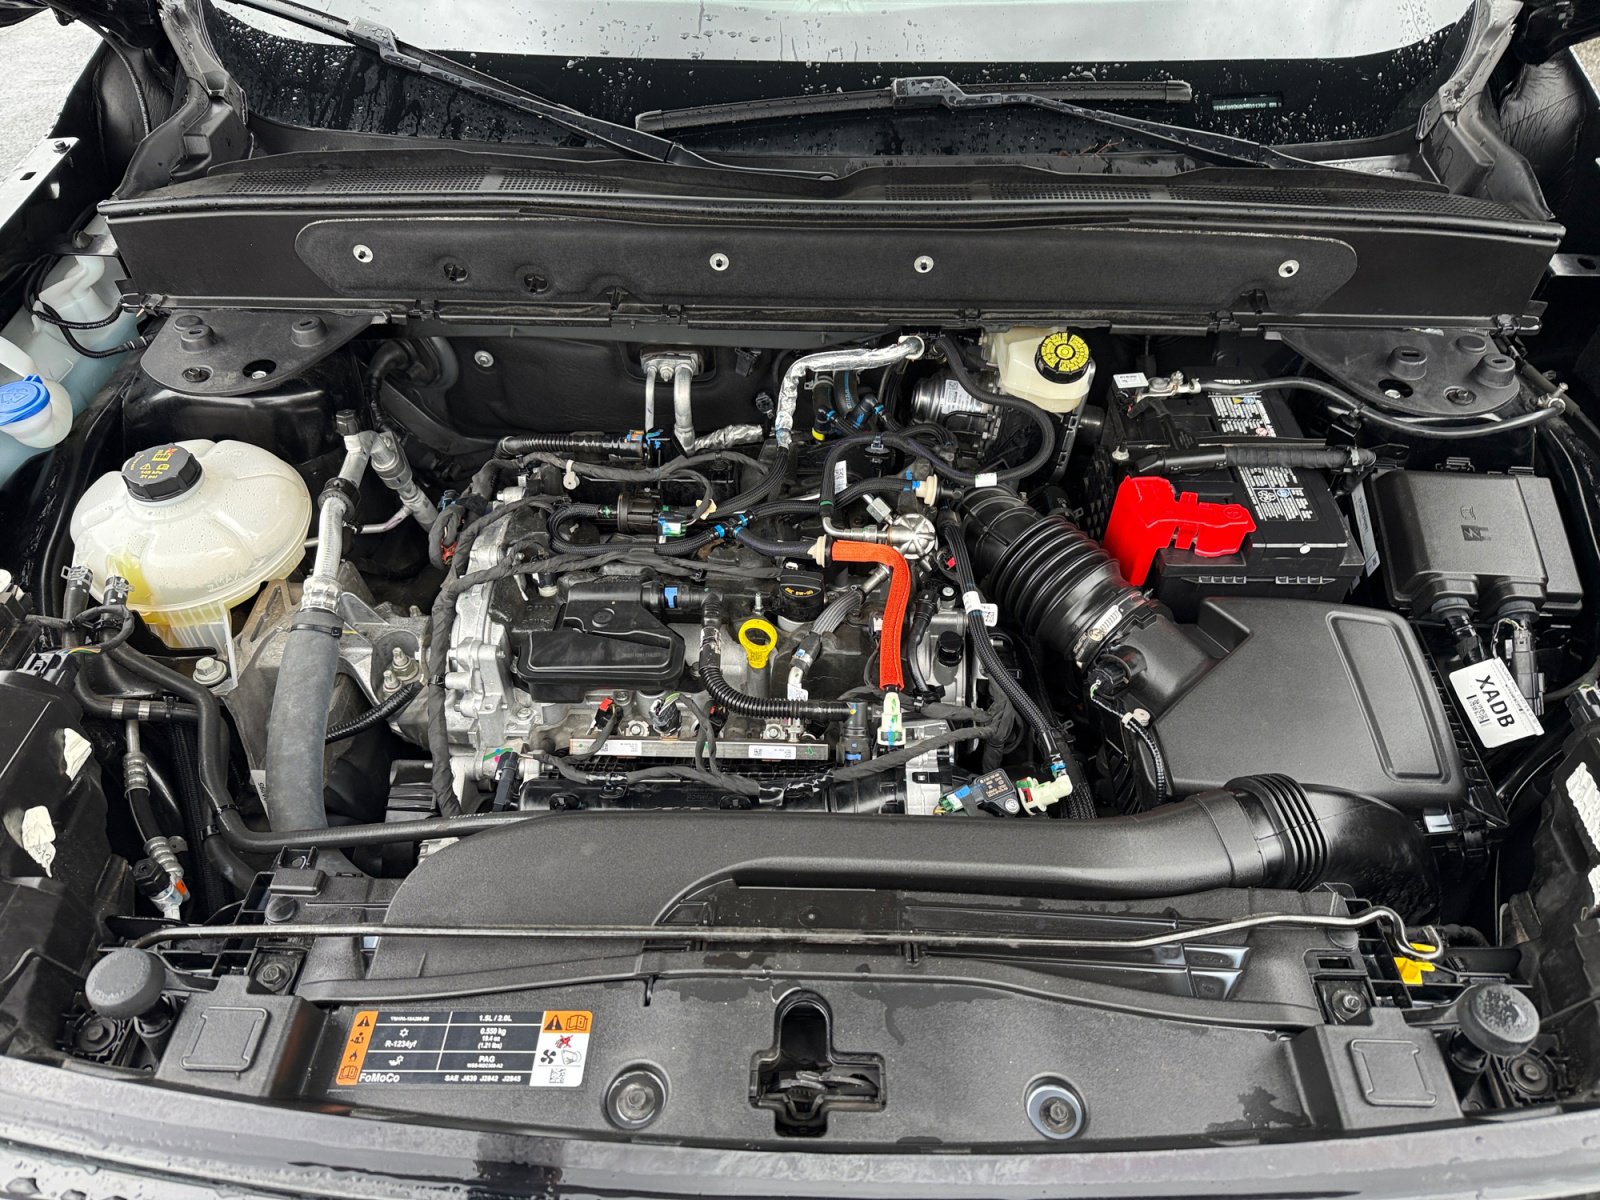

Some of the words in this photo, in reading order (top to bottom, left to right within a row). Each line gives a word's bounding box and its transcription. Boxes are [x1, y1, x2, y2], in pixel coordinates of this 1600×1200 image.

[1475, 675, 1515, 728] XADB
[479, 1014, 493, 1022] 1.5L
[498, 1014, 513, 1022] 2.0L
[480, 1027, 497, 1035] 0.550
[498, 1027, 507, 1037] kg
[384, 1040, 418, 1050] R-1234yf
[478, 1055, 496, 1063] PAG
[358, 1072, 400, 1083] FoMoCo
[444, 1074, 460, 1082] SAE
[460, 1074, 478, 1082] J639
[479, 1074, 499, 1082] J2842
[501, 1074, 522, 1082] J2845
